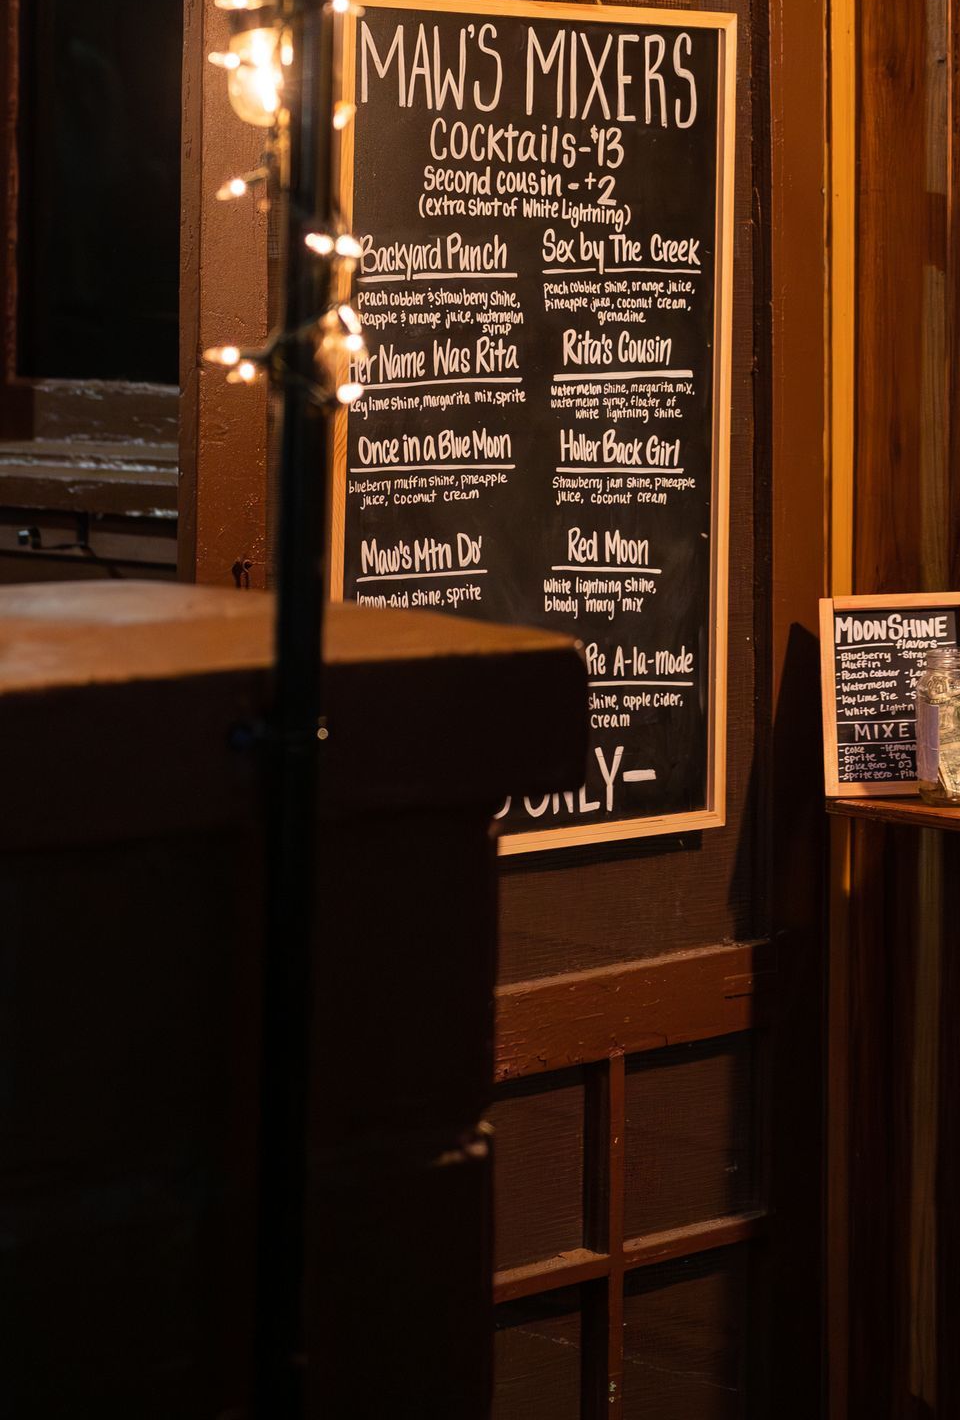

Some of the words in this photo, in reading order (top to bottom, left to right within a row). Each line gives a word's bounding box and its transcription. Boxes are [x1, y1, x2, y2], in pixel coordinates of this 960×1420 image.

[361, 21, 502, 112] MAW'S
[526, 26, 697, 129] MIXERS
[497, 169, 562, 197] cousin
[419, 194, 465, 218] (extra
[468, 197, 502, 216] shot
[503, 198, 518, 217] of
[523, 199, 558, 218] White
[562, 201, 631, 232] Lightning)
[360, 234, 442, 280] Backyard
[447, 232, 507, 271] Punch
[542, 229, 576, 263] Sex
[580, 231, 604, 274] by
[609, 234, 642, 263] The
[651, 234, 701, 265] Creek
[358, 291, 388, 309] peach
[390, 291, 425, 306] cobbler
[435, 288, 488, 310] strawberry
[490, 290, 520, 308] shine,
[570, 281, 601, 293] cobbler
[605, 281, 630, 295] shine,
[632, 281, 664, 297] orange
[667, 280, 695, 294] juice,
[617, 297, 652, 309] coconut
[409, 312, 441, 329] orange
[445, 310, 473, 329] juice,
[476, 310, 524, 324] watermelon
[598, 310, 646, 325] grenadine
[482, 324, 511, 336] syrup
[563, 329, 612, 365] Rita's
[618, 330, 672, 365] Cousin
[379, 344, 425, 382] Name
[434, 338, 470, 376] Was
[476, 336, 519, 373] Rita
[369, 396, 389, 411] lime
[392, 396, 422, 411] shine,
[423, 391, 470, 411] margarita
[496, 389, 526, 407] sprite
[631, 382, 674, 396] margarita
[551, 397, 599, 408] watermelon
[631, 396, 660, 407] floater
[666, 396, 676, 407] of
[607, 409, 648, 423] lightning
[654, 409, 682, 418] shine
[358, 436, 399, 464] Once
[403, 434, 420, 462] in
[424, 435, 435, 461] a
[438, 430, 471, 459] Blue
[472, 428, 511, 459] Moon
[560, 429, 601, 462] Holler
[603, 429, 642, 465] Back
[646, 435, 680, 466] Girl
[349, 479, 391, 495] blueberry
[394, 476, 427, 490] muffin
[461, 473, 507, 489] pineapple
[606, 477, 622, 492] jam
[360, 494, 388, 510] juice,
[394, 490, 437, 504] coconut
[444, 490, 479, 501] cream
[556, 491, 583, 505] juice,
[591, 491, 632, 505] coconut
[637, 491, 666, 505] cream
[361, 538, 412, 574] Maw's
[414, 538, 452, 572] Mtn
[568, 527, 598, 563] Red
[605, 529, 648, 565] Moon
[412, 589, 444, 606] shine,
[446, 584, 481, 609] sprite
[576, 577, 621, 601] lightning
[625, 577, 656, 594] shine,
[544, 595, 578, 619] bloody
[586, 597, 614, 620] mary
[622, 598, 643, 613] mix
[895, 639, 937, 649] flavors
[586, 642, 606, 676] Pie
[842, 660, 880, 669] Muffin
[623, 692, 650, 710] apple
[880, 691, 898, 700] Pie
[591, 713, 630, 728] cream
